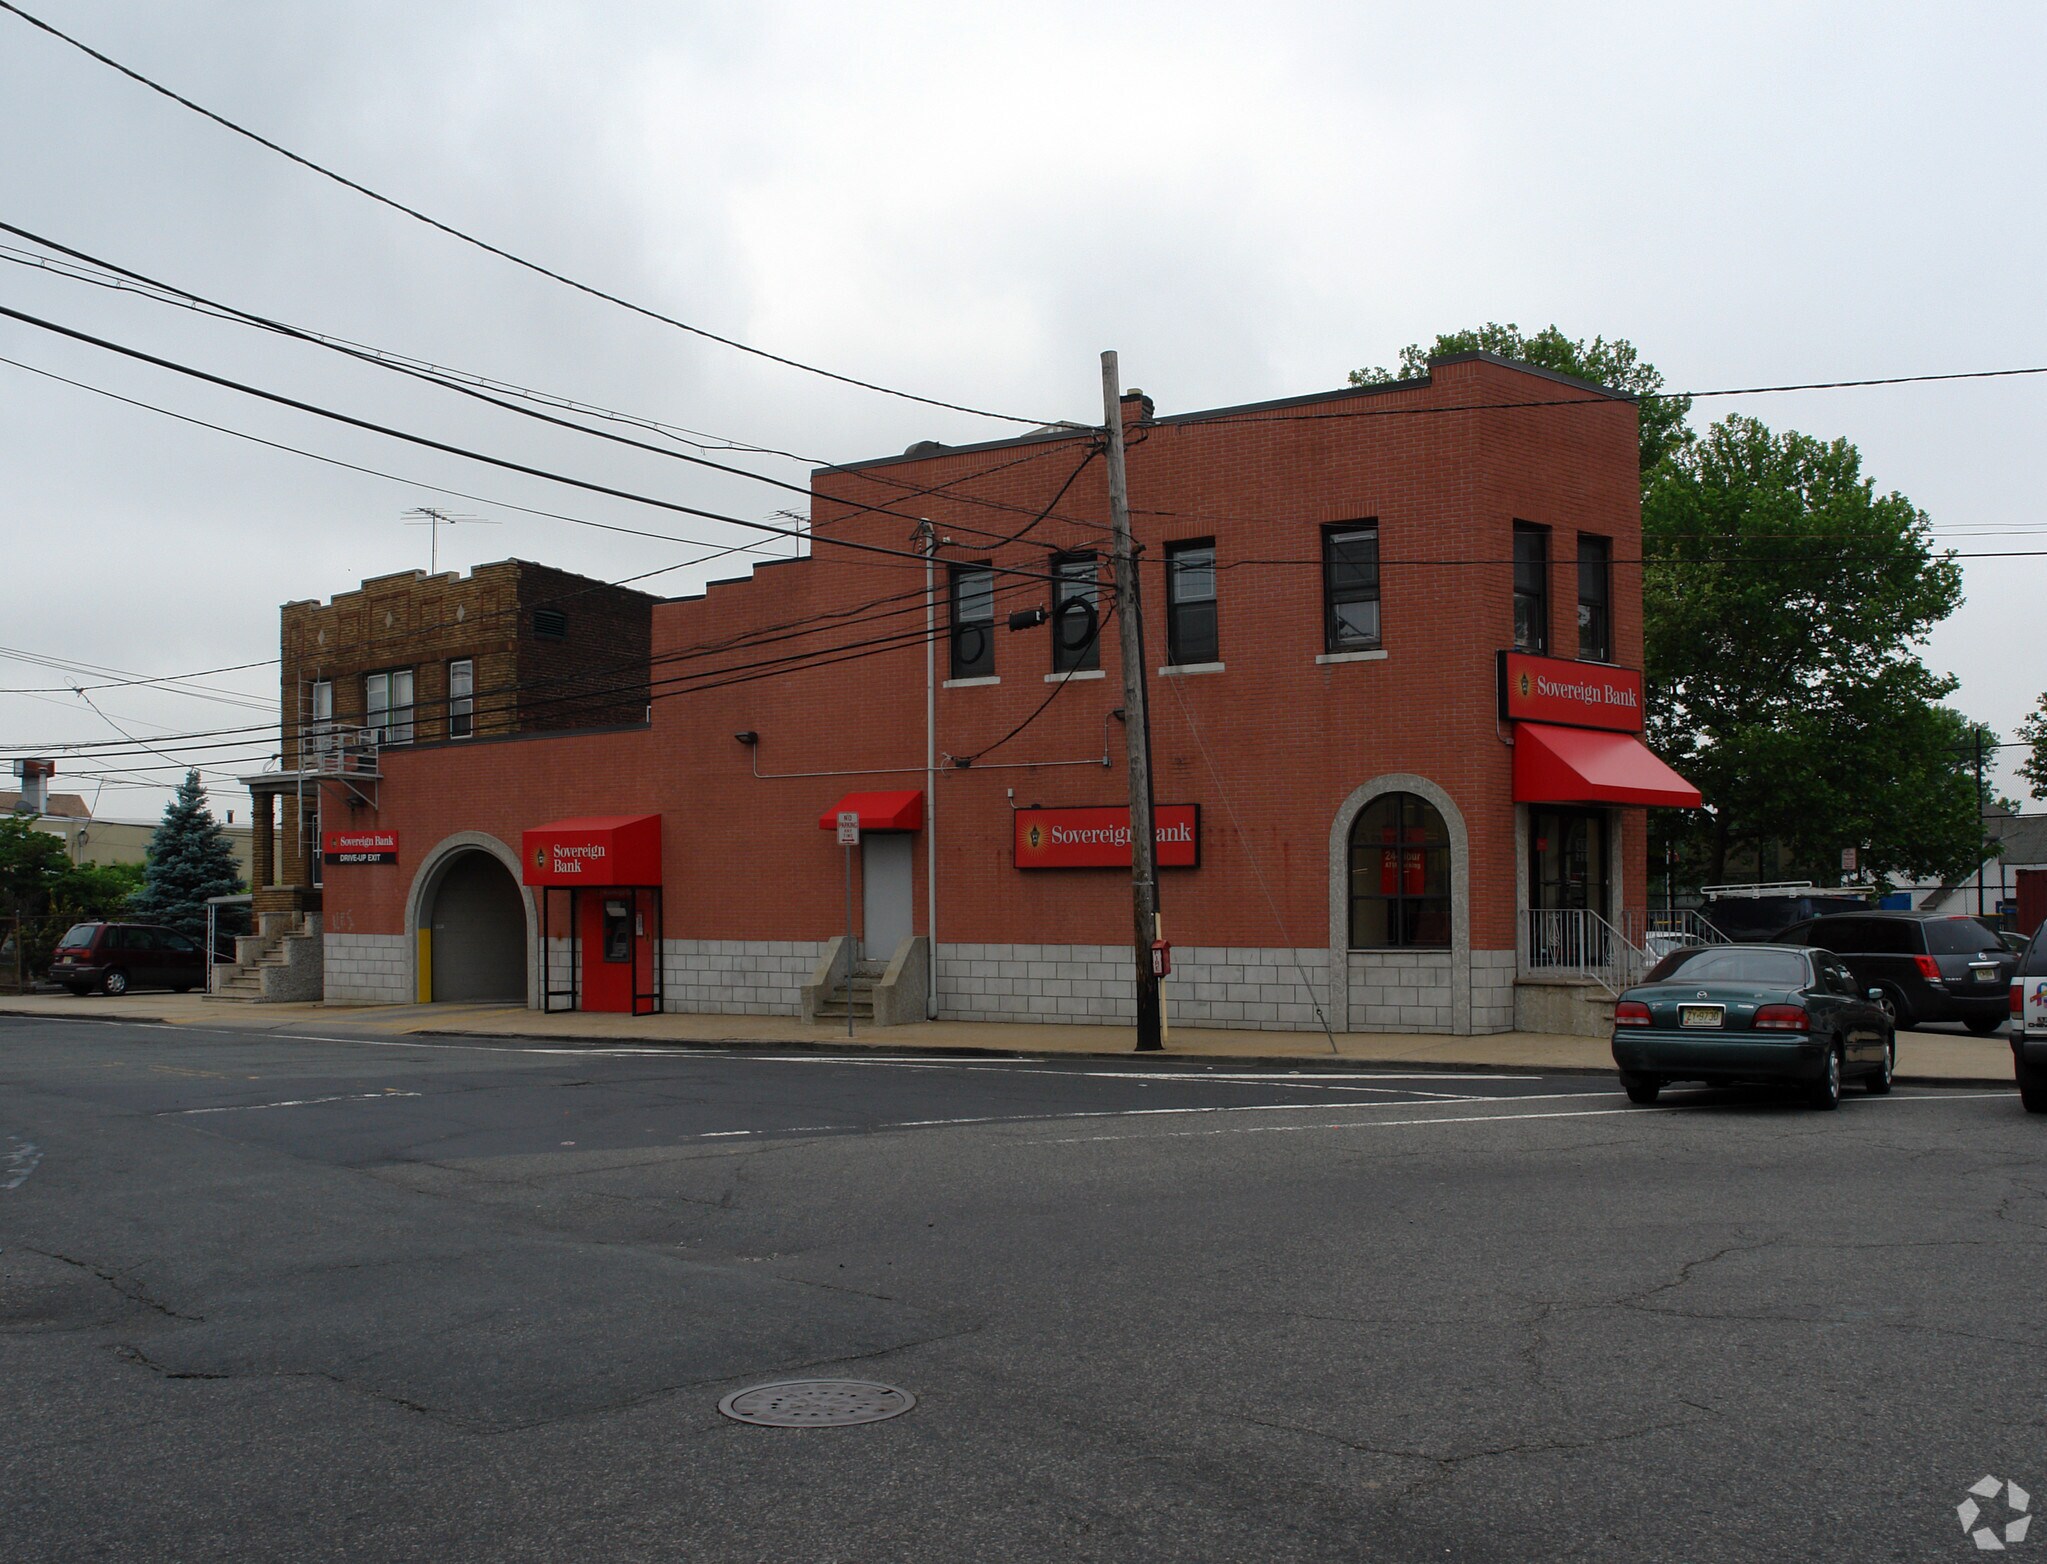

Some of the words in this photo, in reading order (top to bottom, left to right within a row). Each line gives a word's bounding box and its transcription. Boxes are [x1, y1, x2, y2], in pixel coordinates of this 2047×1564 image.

[1537, 675, 1601, 705] Sovereign
[1604, 685, 1637, 707] Bank
[1156, 823, 1192, 842] ank
[340, 836, 373, 848] Sovereign
[375, 836, 393, 846] Bank
[340, 854, 366, 862] DRIVE-UP
[367, 853, 381, 862] EXIT
[553, 843, 605, 859] Sovereign
[554, 859, 581, 873] Bank
